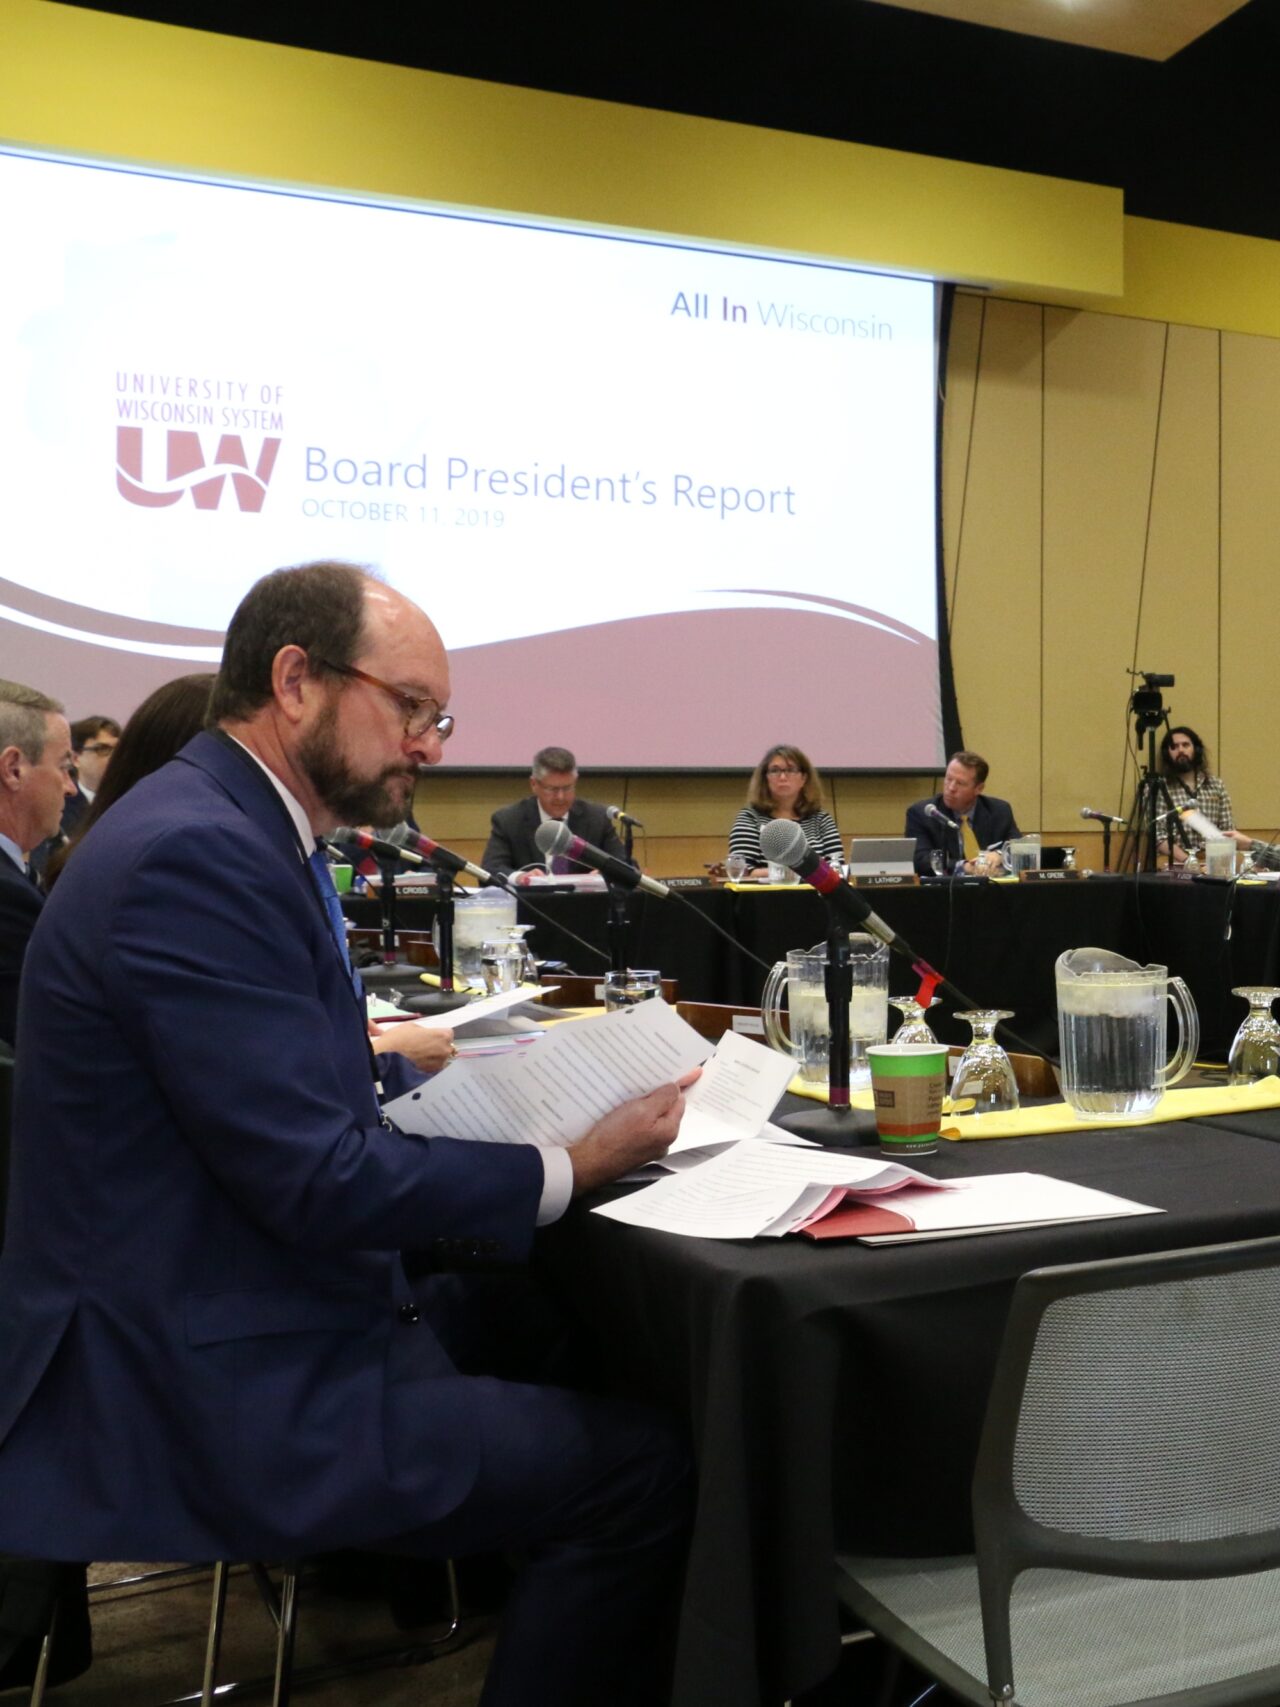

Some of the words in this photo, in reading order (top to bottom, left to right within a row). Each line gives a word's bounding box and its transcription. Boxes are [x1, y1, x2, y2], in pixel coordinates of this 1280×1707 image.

[670, 291, 708, 320] All
[722, 296, 747, 323] In
[757, 300, 893, 341] Wisconsin
[116, 371, 248, 402] UNIVERSITY
[260, 384, 283, 405] OF
[116, 398, 213, 425] WISCONSIN
[222, 407, 284, 431] SYSTEM
[116, 425, 282, 513] UW
[306, 446, 426, 489] Board
[448, 457, 657, 505] President's
[674, 474, 796, 520] Report
[302, 498, 408, 522] OCTOBER
[454, 508, 505, 528] 2019
